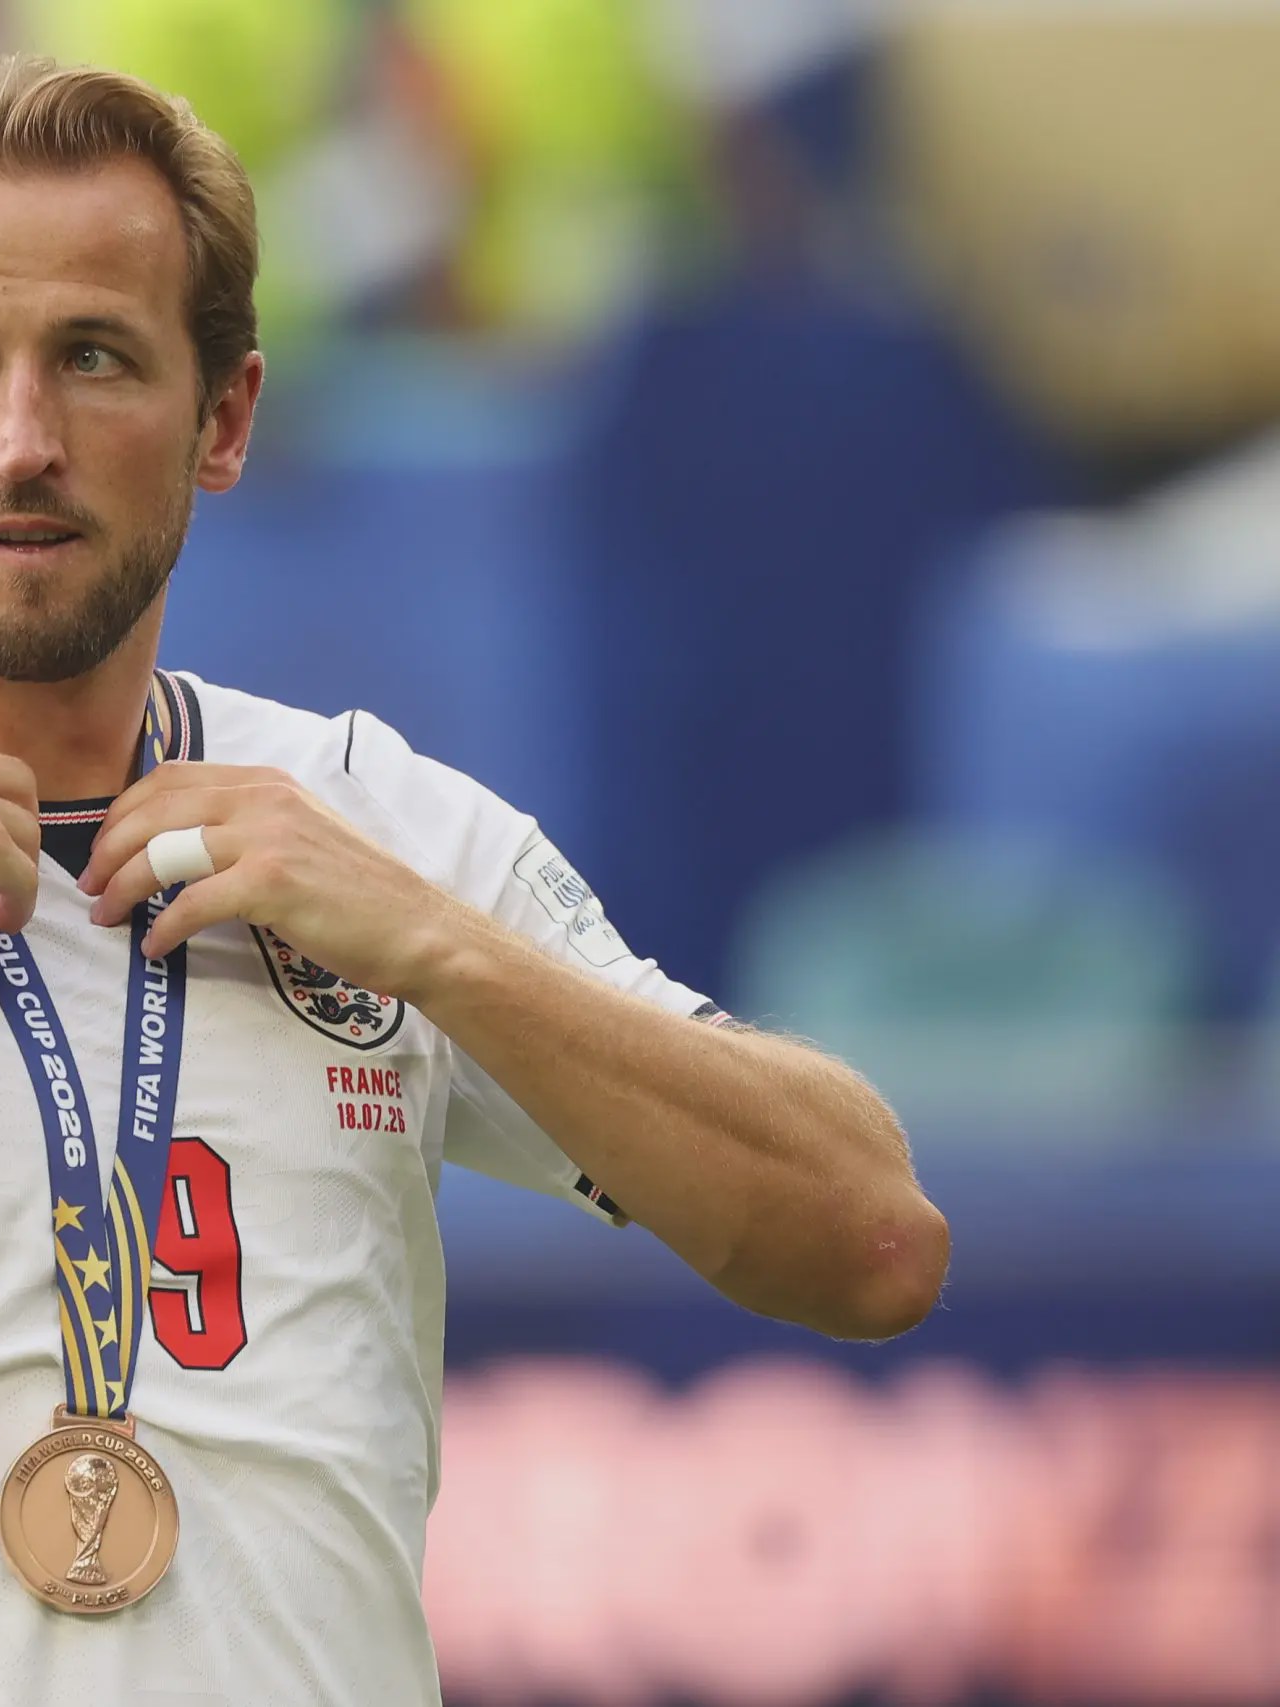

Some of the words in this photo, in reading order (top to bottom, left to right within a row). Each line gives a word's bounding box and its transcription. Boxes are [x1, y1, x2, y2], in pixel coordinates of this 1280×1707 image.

[139, 957, 169, 1065] WORLD
[17, 992, 56, 1050] CUP
[41, 1053, 86, 1169] 2026
[133, 1073, 162, 1142] FIFA
[326, 1066, 402, 1099] FRANCE
[337, 1102, 406, 1134] 18.07.26
[147, 1137, 248, 1371] 9
[95, 1434, 124, 1451] CUP
